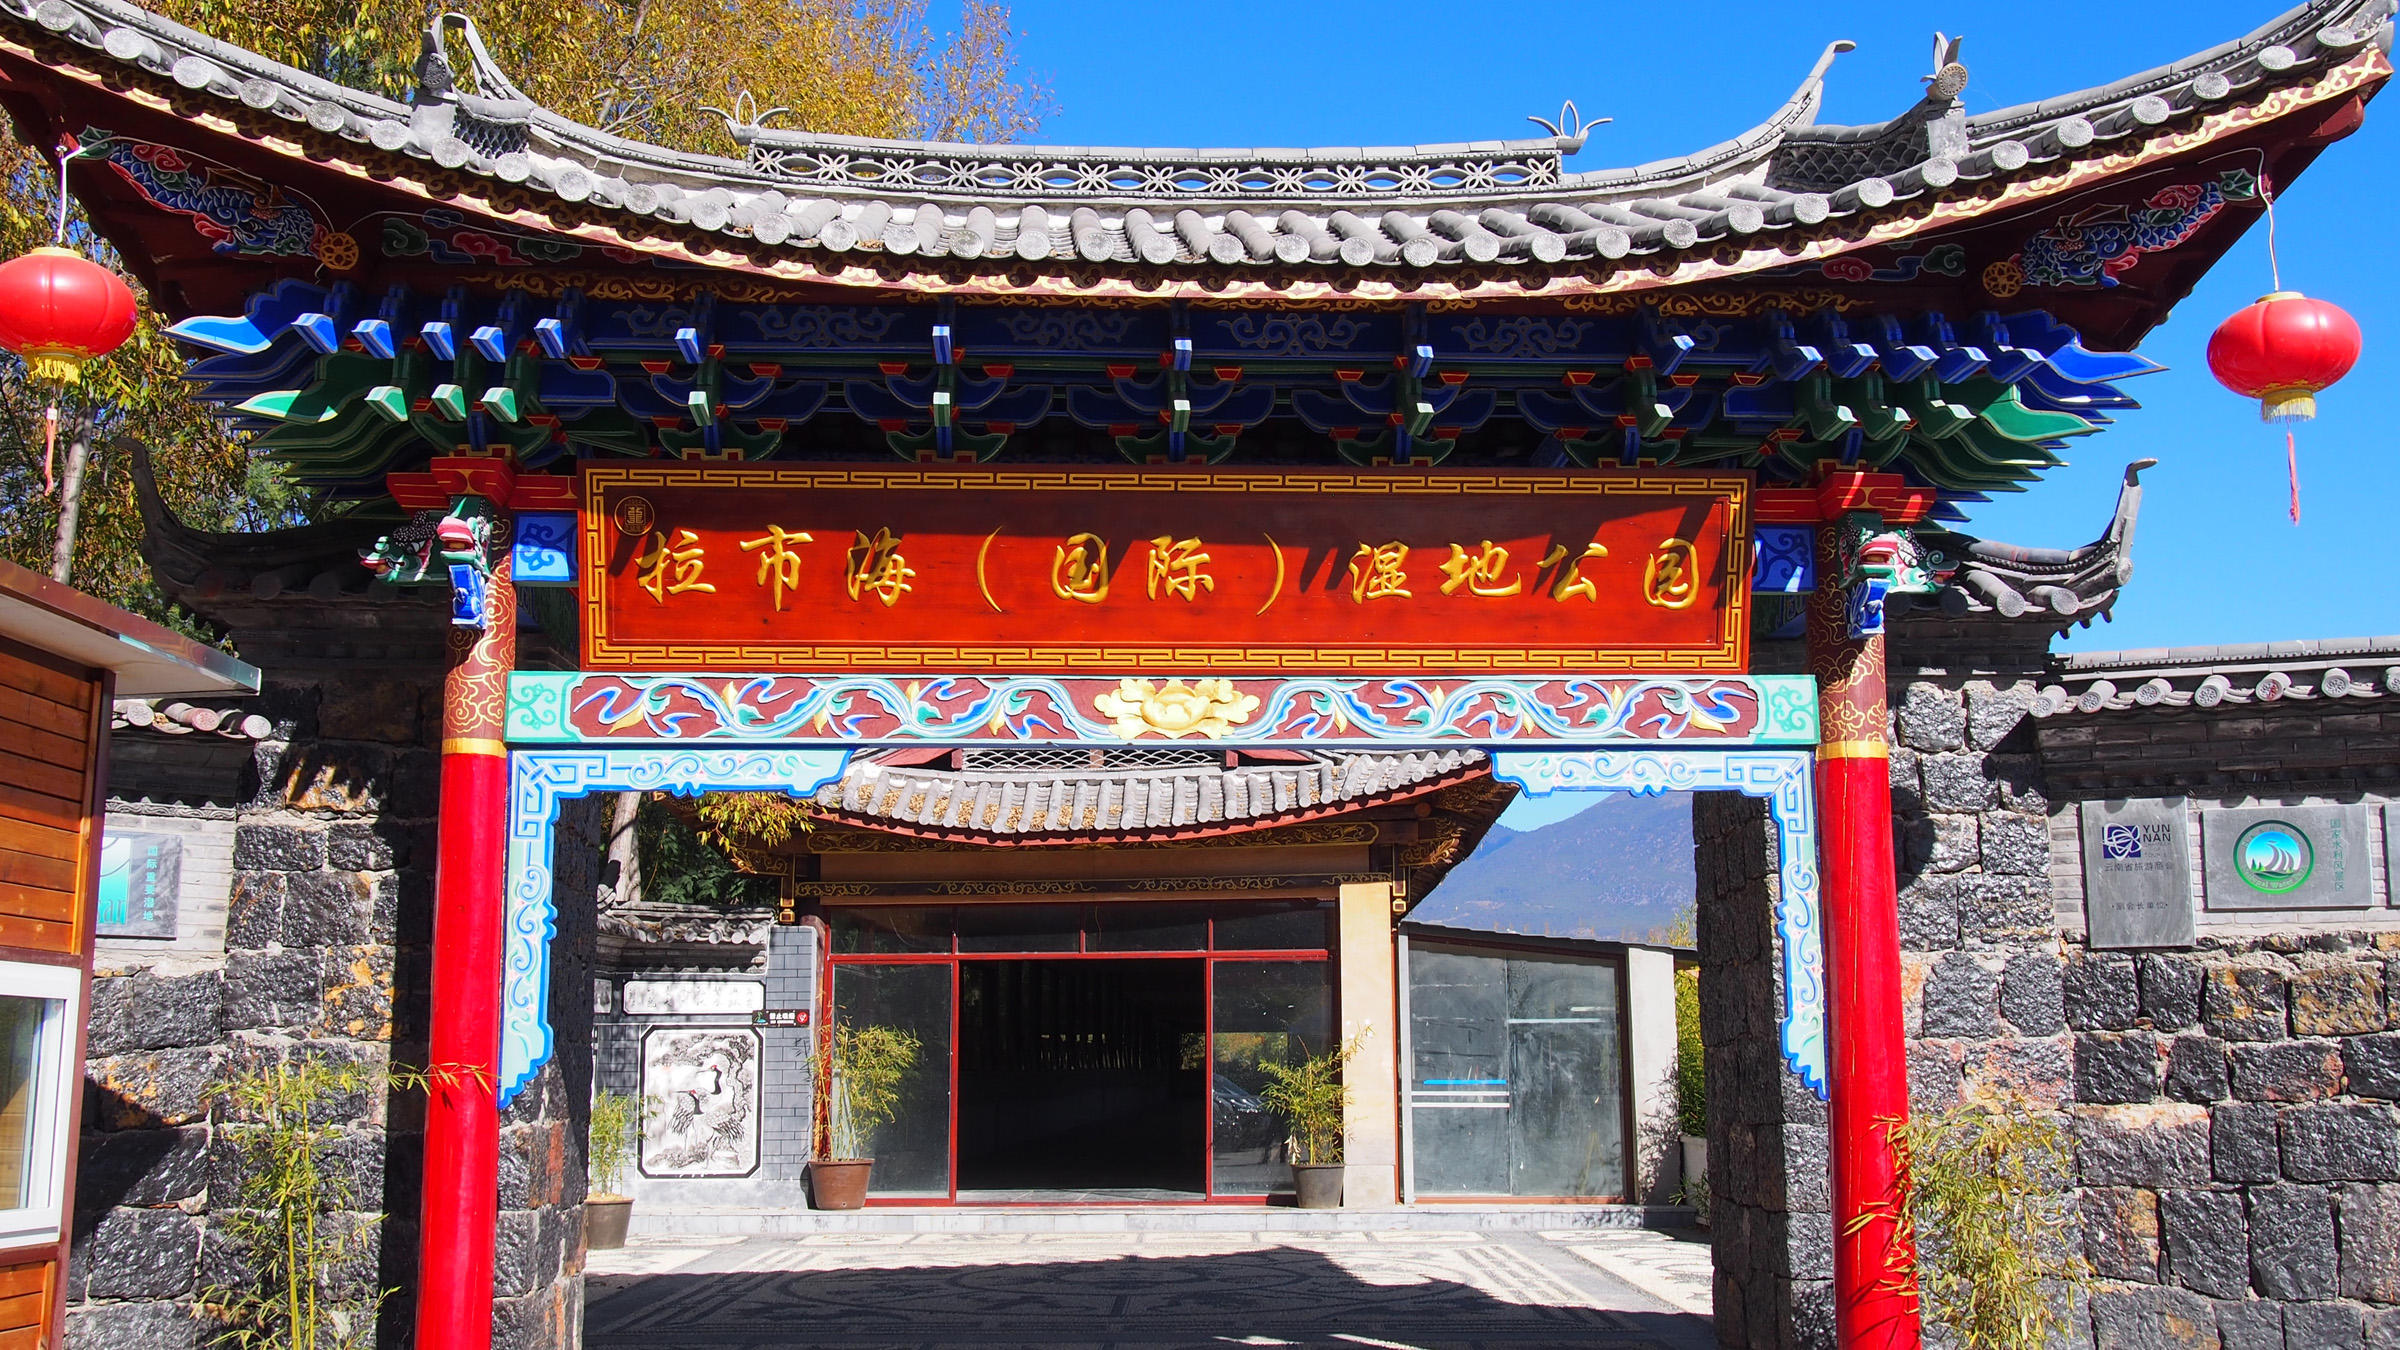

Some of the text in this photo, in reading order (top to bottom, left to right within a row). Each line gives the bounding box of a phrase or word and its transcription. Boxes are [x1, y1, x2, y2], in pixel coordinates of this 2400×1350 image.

[634, 524, 1699, 616] 拉市海（国际）湿地公园
[2143, 824, 2171, 833] YUN
[2143, 833, 2172, 842] NAN
[143, 845, 159, 921] 国际重要湿地
